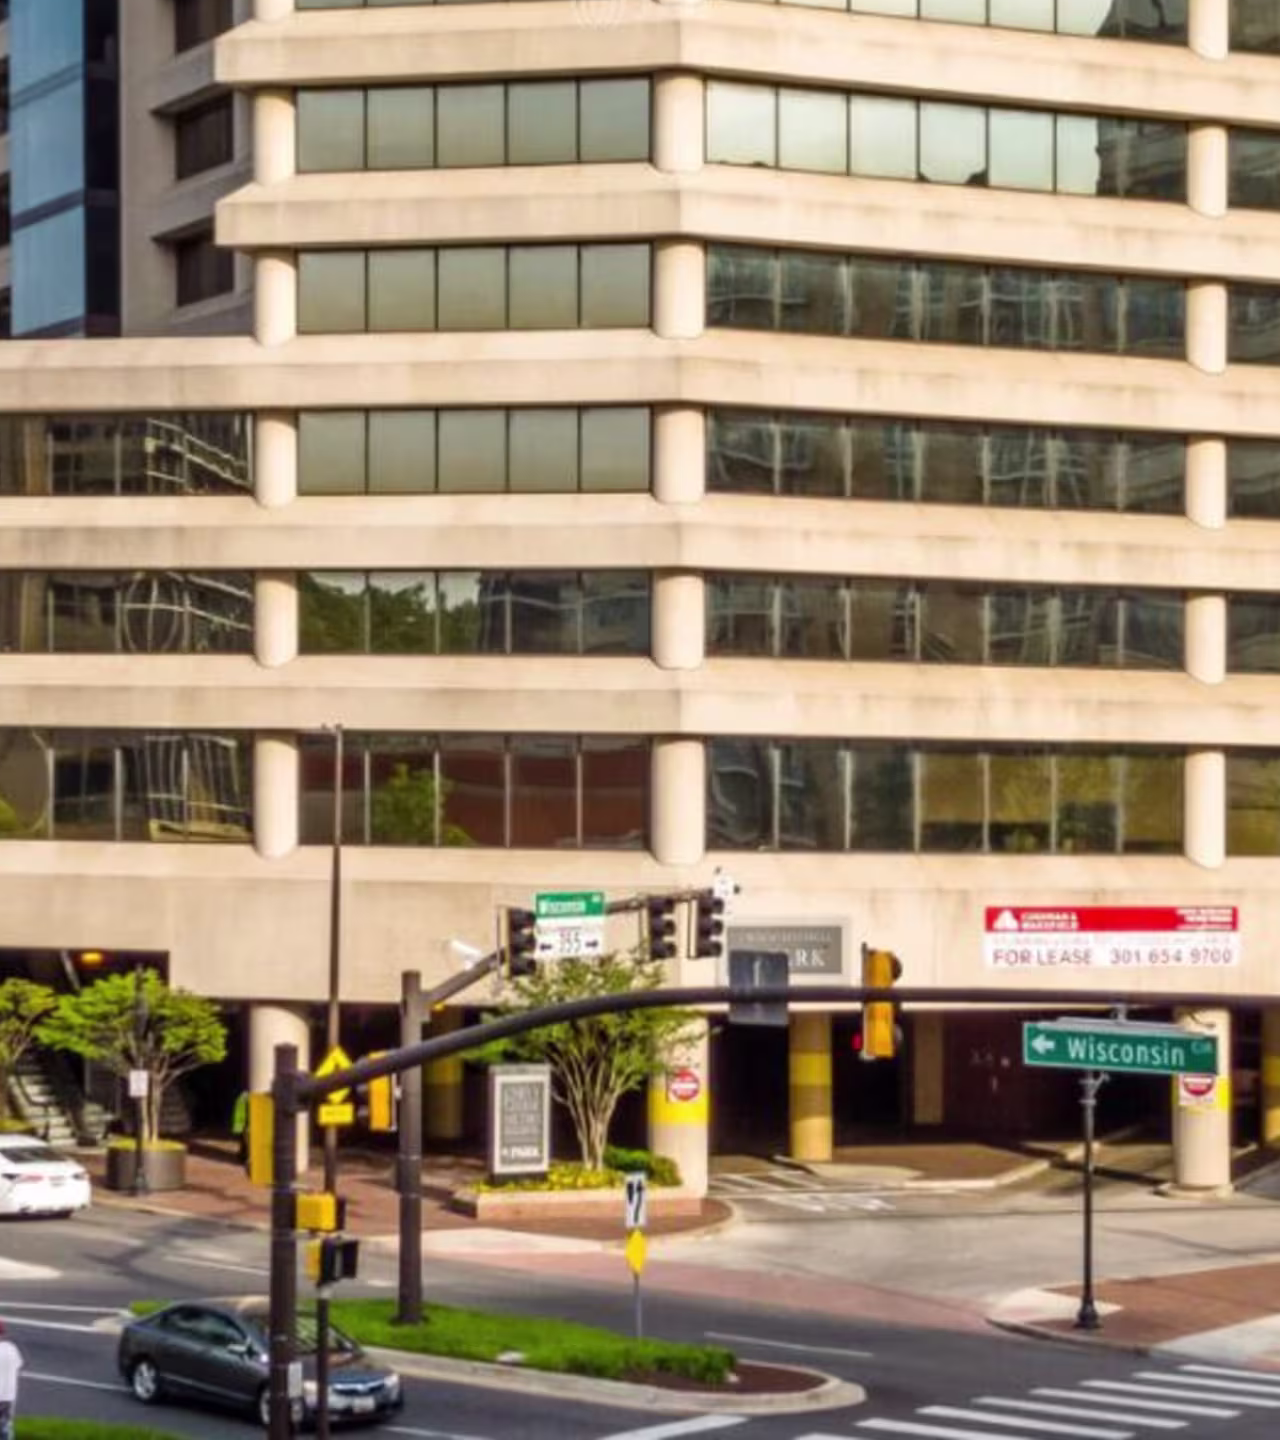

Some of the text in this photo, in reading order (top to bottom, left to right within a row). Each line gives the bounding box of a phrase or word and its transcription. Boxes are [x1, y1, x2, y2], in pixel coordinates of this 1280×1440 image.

[993, 948, 1233, 965] FOR LEASE 301 654 9700
[1067, 1036, 1185, 1067] Wisconsin
